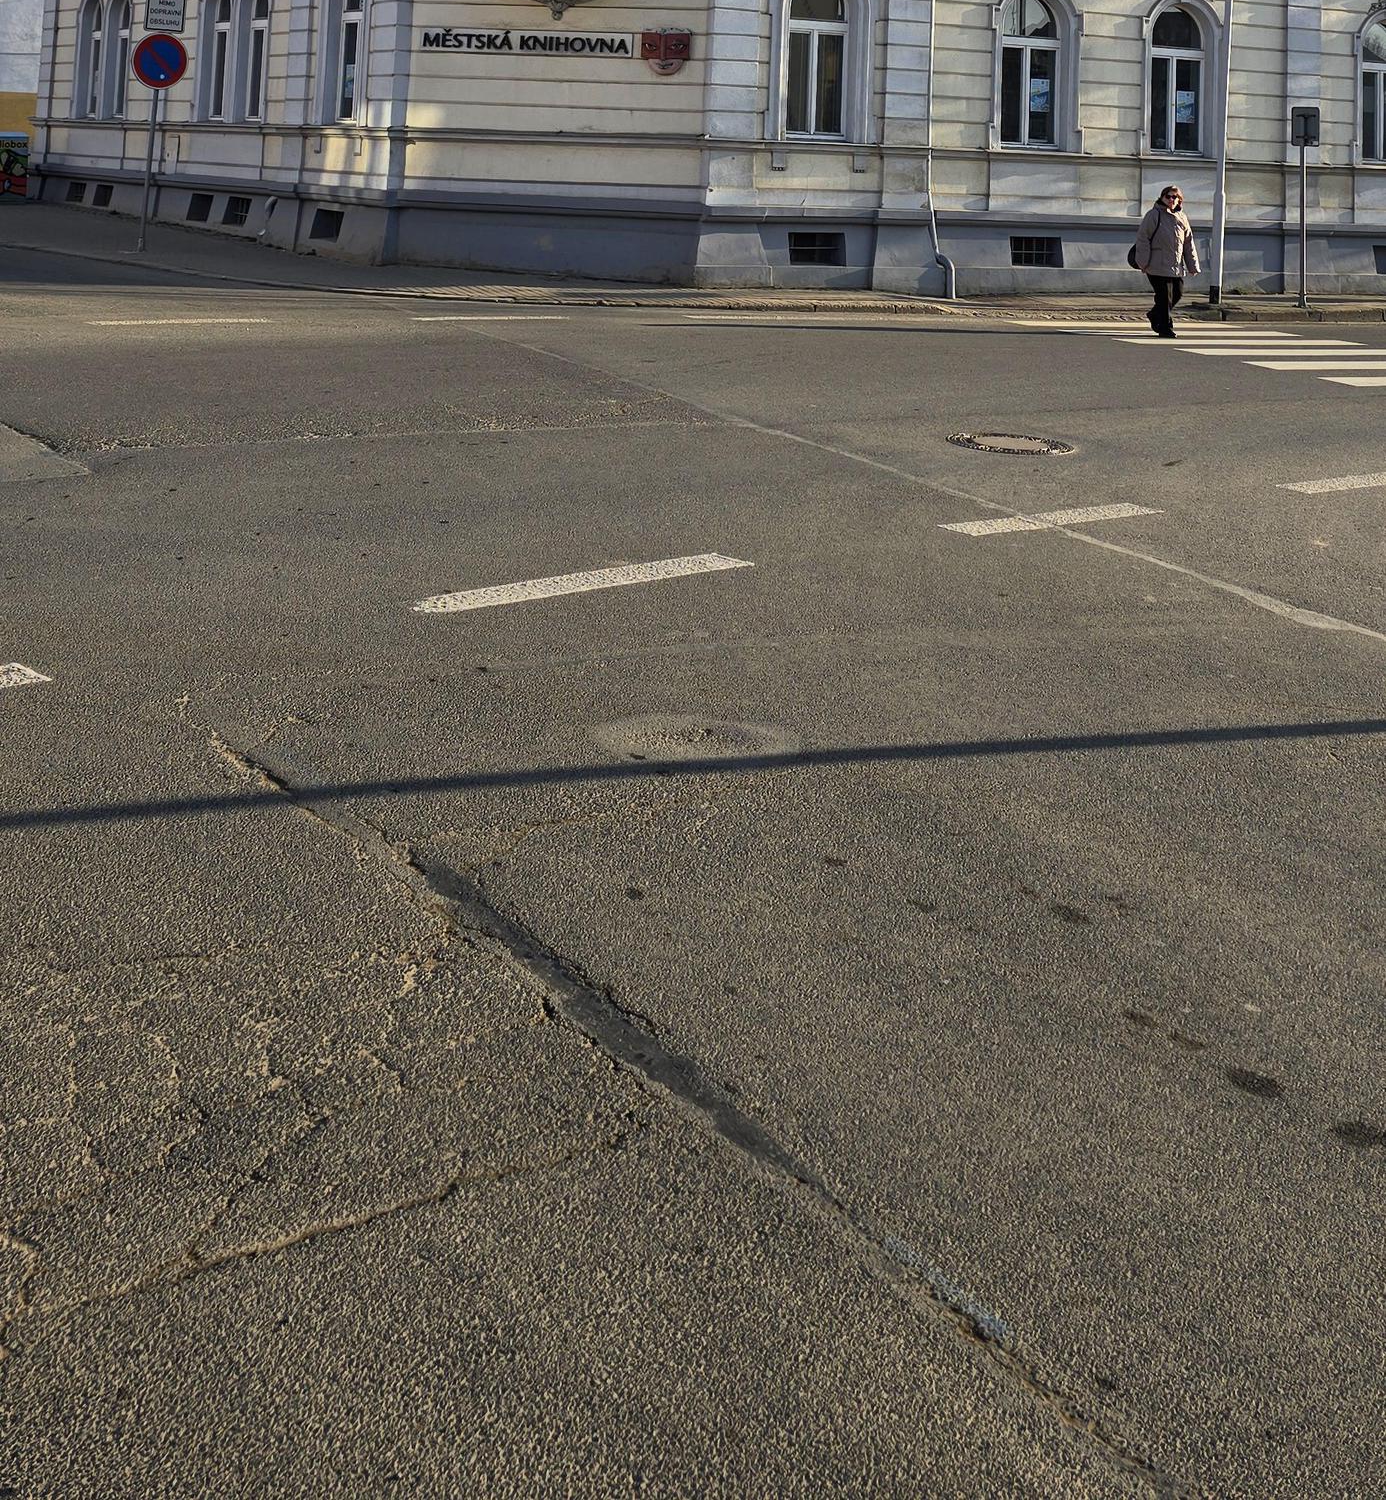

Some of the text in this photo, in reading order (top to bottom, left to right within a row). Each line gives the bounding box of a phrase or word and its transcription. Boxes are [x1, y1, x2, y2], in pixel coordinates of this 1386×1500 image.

[150, 18, 180, 26] OBSLUHU
[422, 28, 630, 54] MĚSTSKÁ KNIHOVNA
